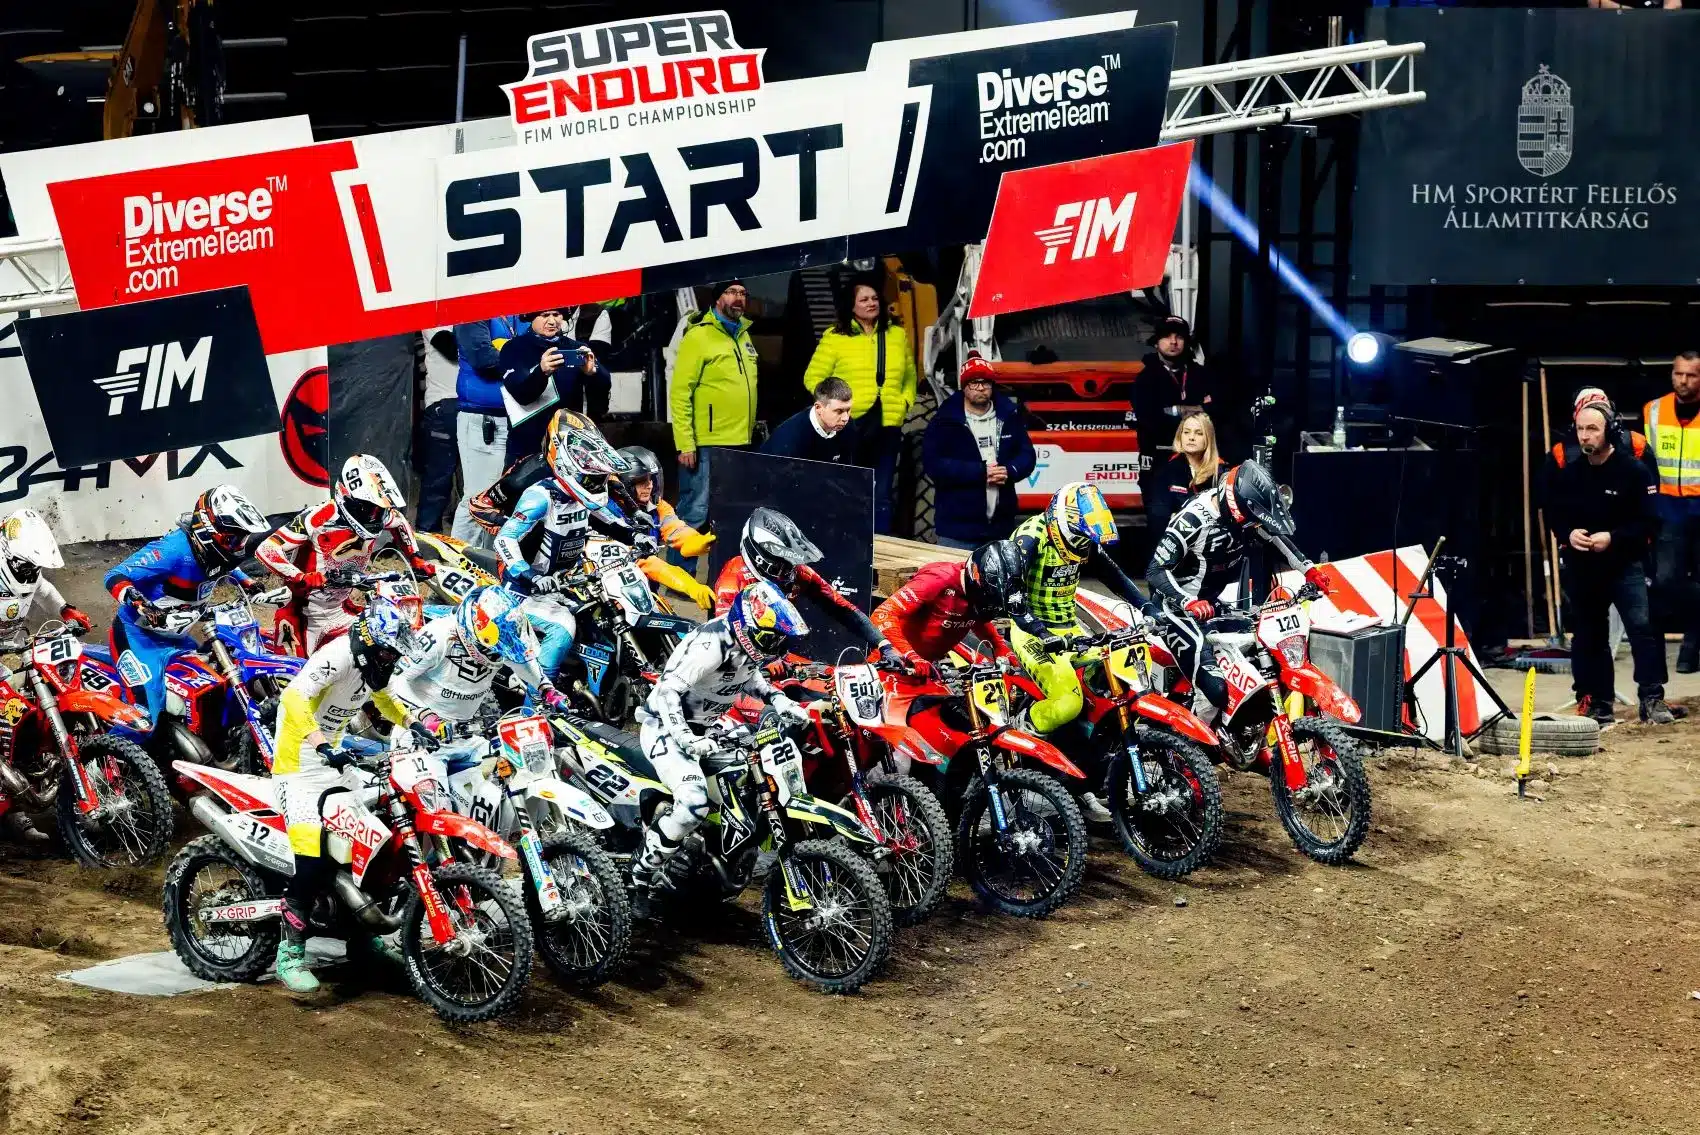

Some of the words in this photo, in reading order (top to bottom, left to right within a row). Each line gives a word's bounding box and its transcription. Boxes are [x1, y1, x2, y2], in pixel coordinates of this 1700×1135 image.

[532, 15, 733, 76] SUPER
[510, 53, 760, 124] ENDURO
[977, 64, 1107, 112] Diverse
[524, 128, 553, 145] FIM
[561, 117, 620, 137] WORLD
[627, 97, 757, 127] CHAMPIONSHIP
[979, 102, 1109, 139] ExtremeTeam
[979, 138, 1026, 163] .com
[445, 123, 844, 277] START
[1412, 185, 1455, 204] HM
[123, 187, 273, 240] Diverse
[1033, 192, 1137, 264] FIM
[124, 224, 274, 268] ExtremeTeam
[125, 263, 178, 295] .com
[93, 336, 213, 416] FIM
[1085, 472, 1138, 481] ENDU
[1092, 464, 1139, 472] SUPE
[556, 509, 587, 525] SHO
[442, 572, 475, 595] 83
[1276, 614, 1300, 633] 120
[51, 639, 72, 661] 21
[772, 742, 795, 765] 22
[586, 764, 630, 799] 22
[250, 822, 270, 841] 12
[330, 805, 382, 847] X-GRIP
[216, 906, 256, 919] X-GRIP
[408, 955, 426, 986] X-GRIP
